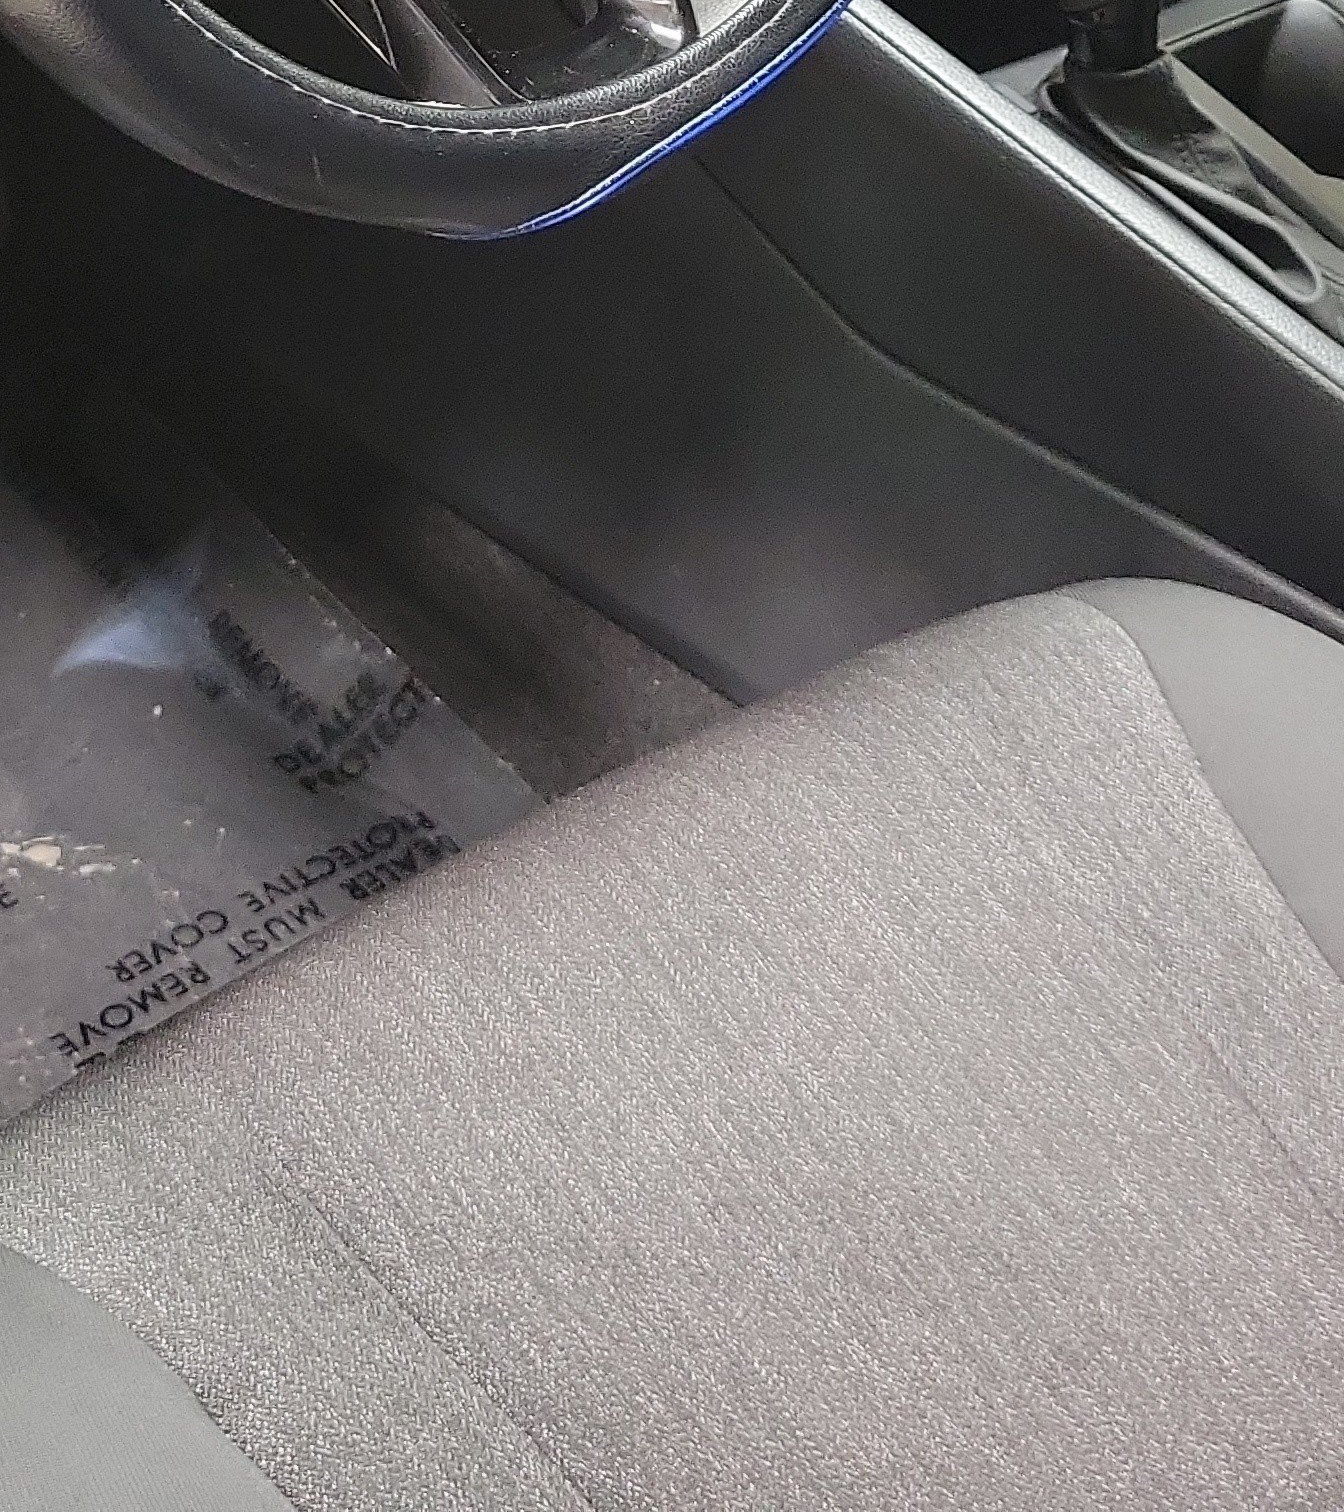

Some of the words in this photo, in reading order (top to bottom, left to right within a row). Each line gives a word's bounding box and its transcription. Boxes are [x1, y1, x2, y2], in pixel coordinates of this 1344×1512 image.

[238, 810, 436, 913] PROTECTIVE
[105, 909, 229, 983] COVER
[227, 897, 325, 965] MUST
[50, 960, 212, 1059] REMOVE
